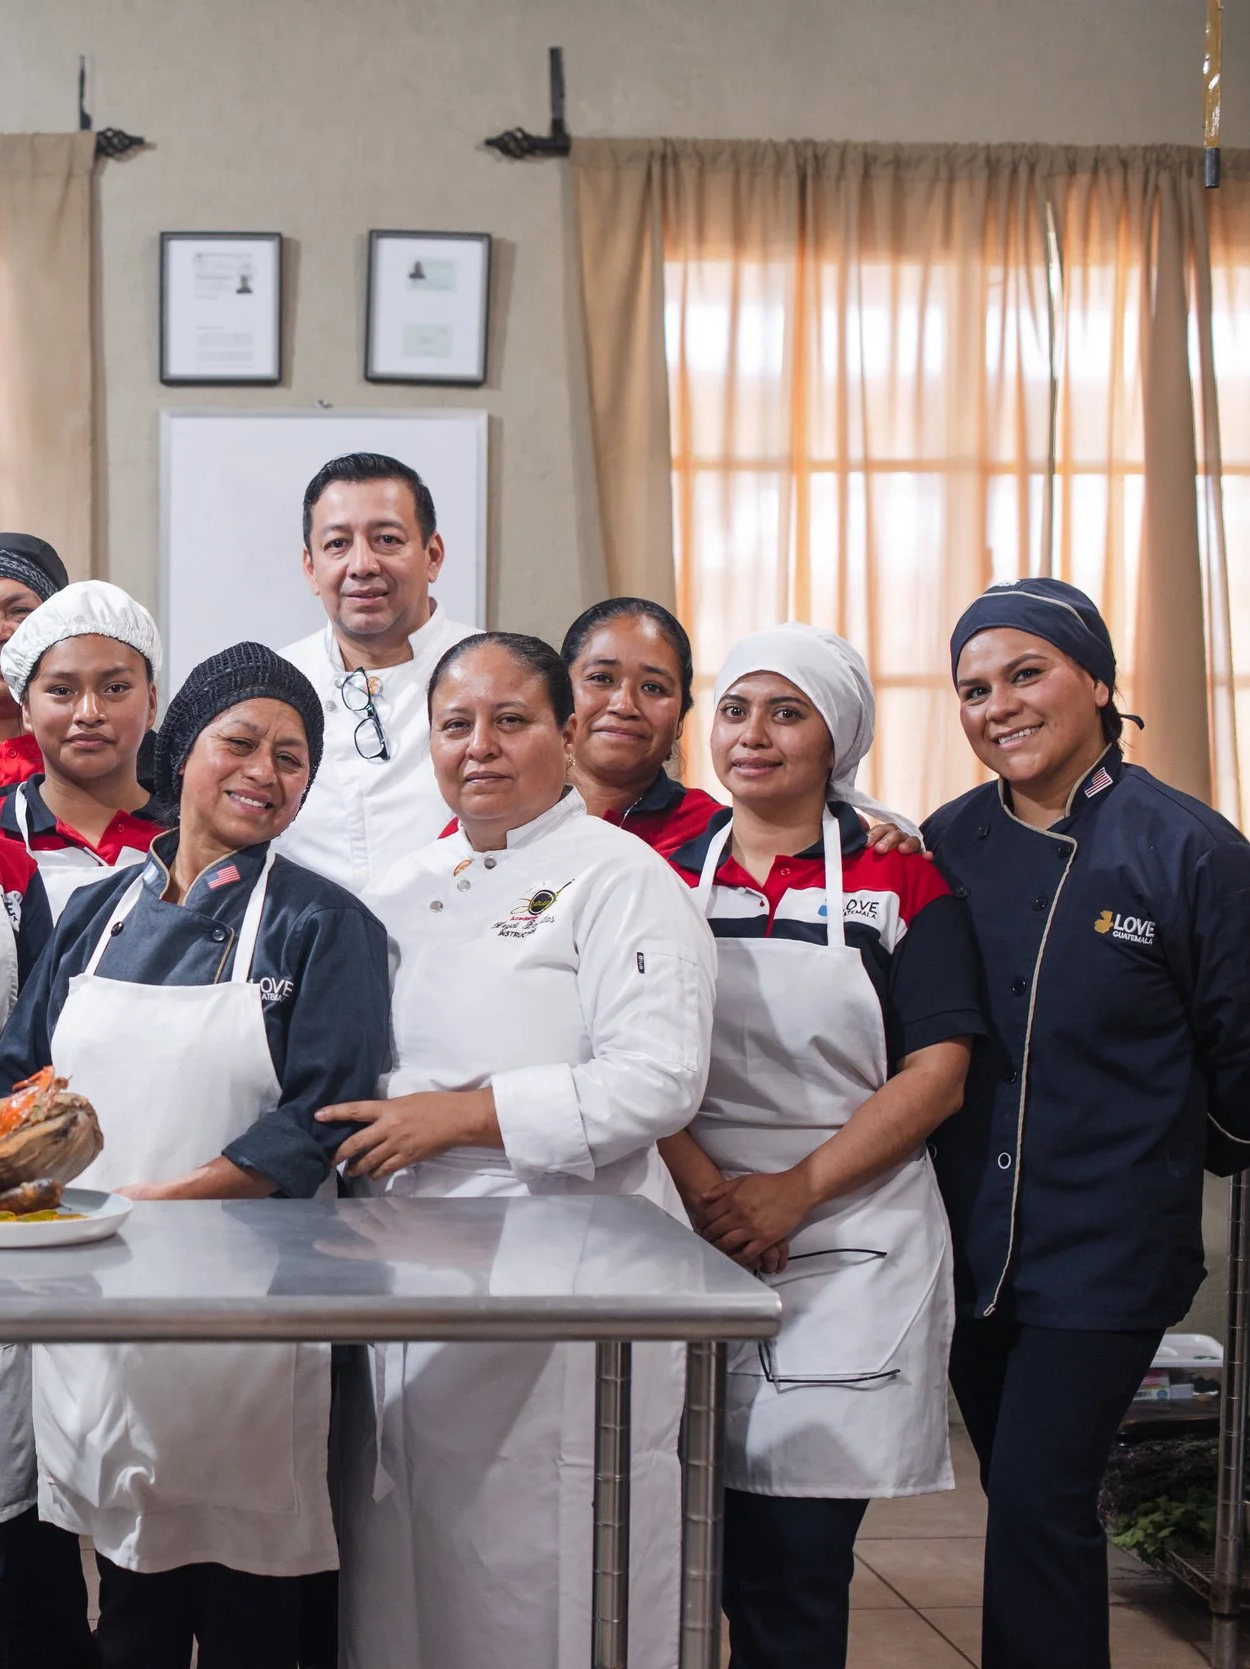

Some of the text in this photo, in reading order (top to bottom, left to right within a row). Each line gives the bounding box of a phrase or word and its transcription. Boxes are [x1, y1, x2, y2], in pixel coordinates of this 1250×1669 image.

[846, 899, 879, 914] OVE
[843, 910, 876, 919] ATEMALA
[1113, 913, 1156, 938] LOVE
[1112, 930, 1153, 945] GUATEMALA
